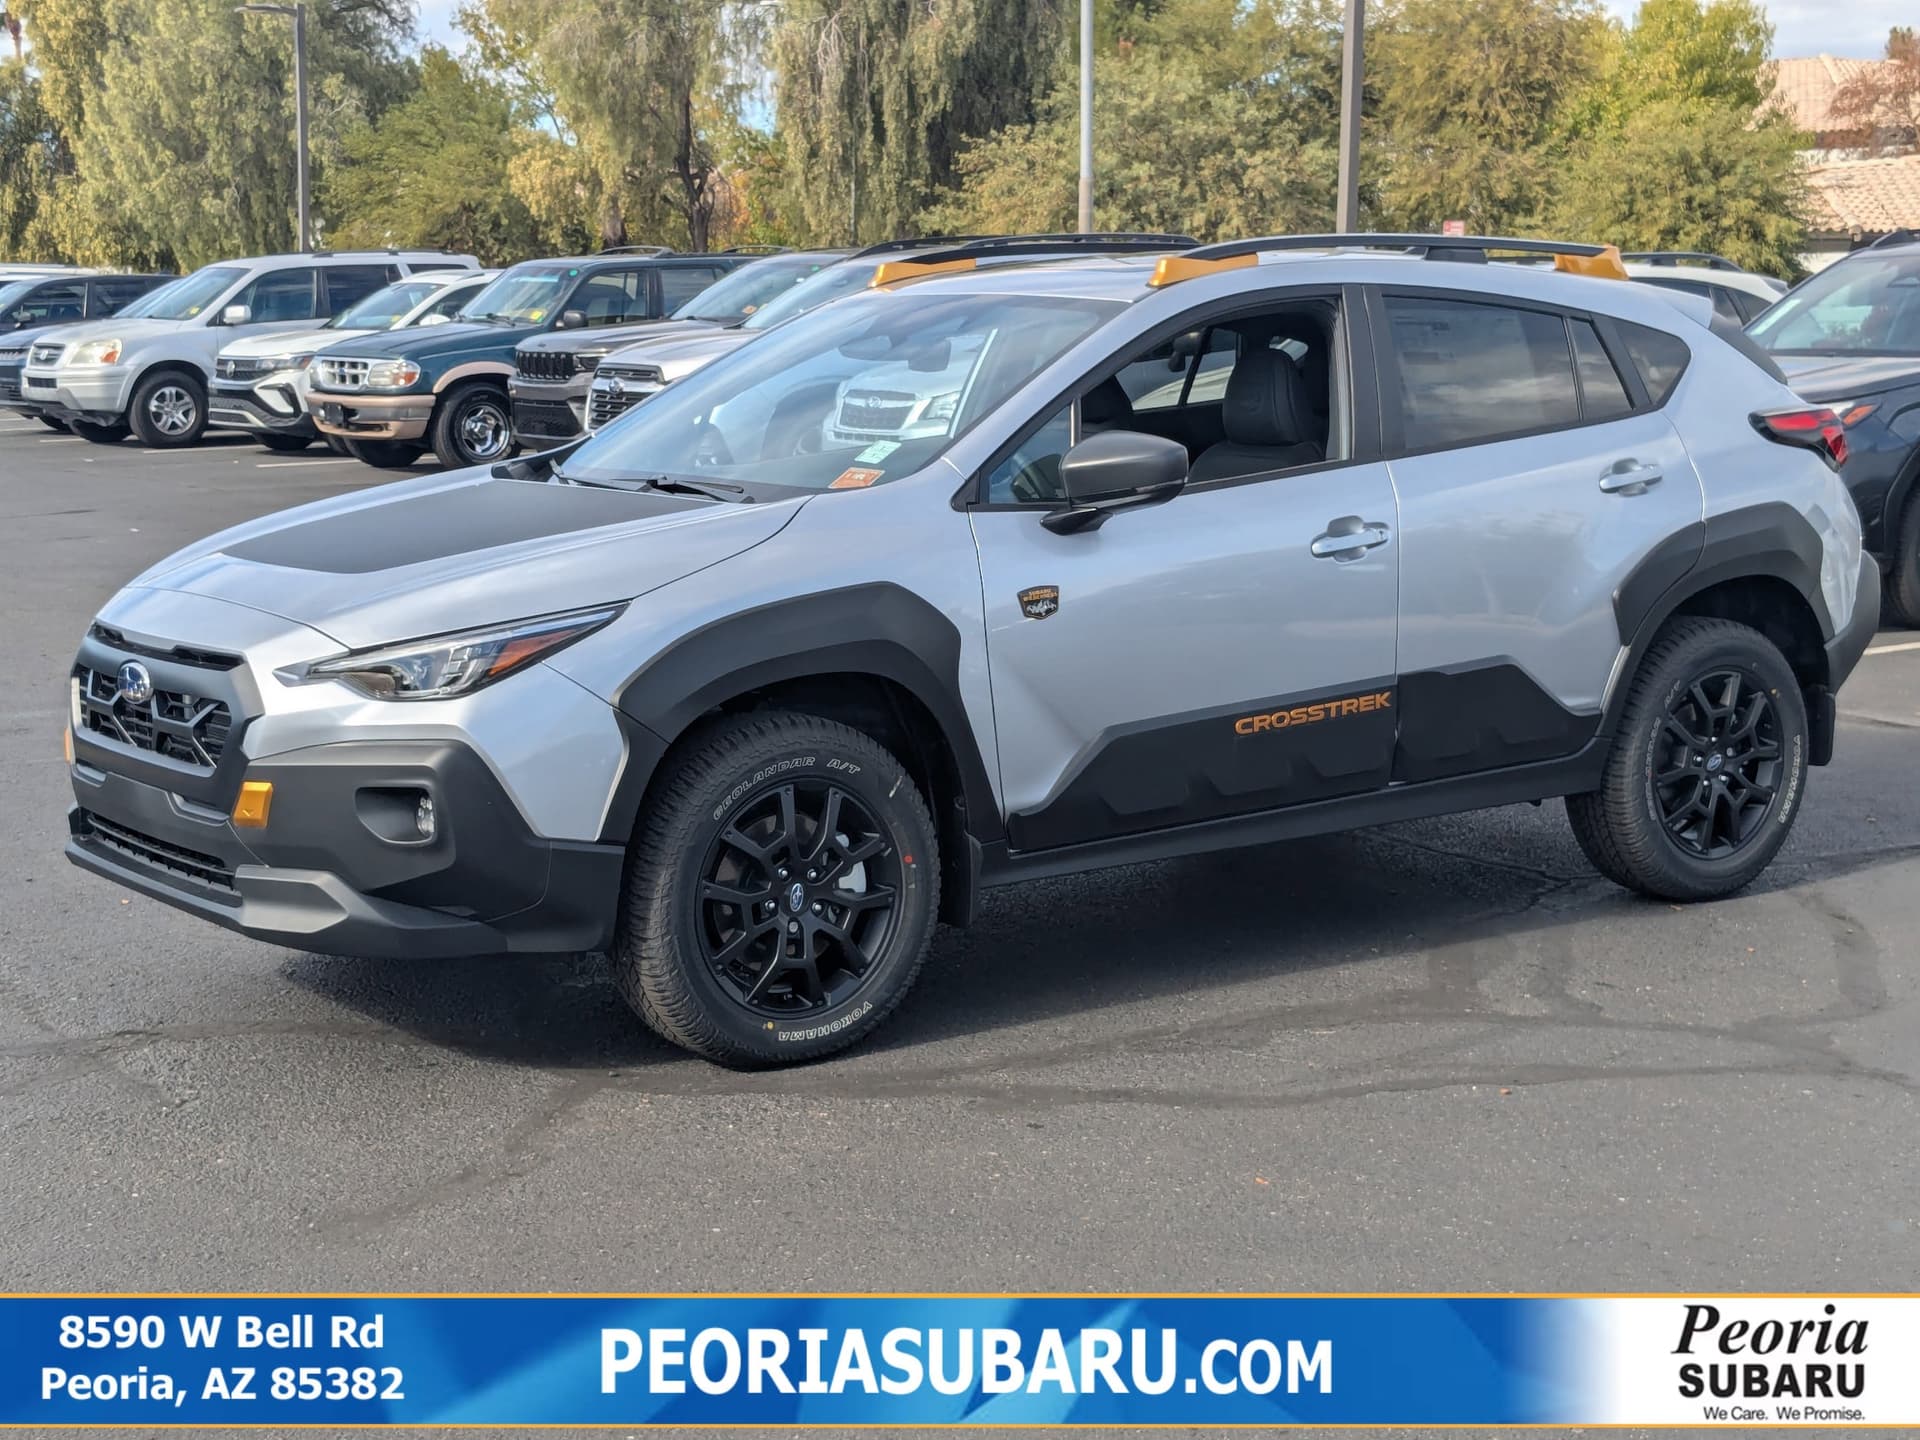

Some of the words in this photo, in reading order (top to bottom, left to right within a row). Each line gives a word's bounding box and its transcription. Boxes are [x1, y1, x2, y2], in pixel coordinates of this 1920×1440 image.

[1235, 692, 1391, 734] CROSSTREK
[712, 756, 817, 821] GEOLANDAR
[827, 758, 861, 775] A/T
[778, 1000, 873, 1041] YOKOHAMA
